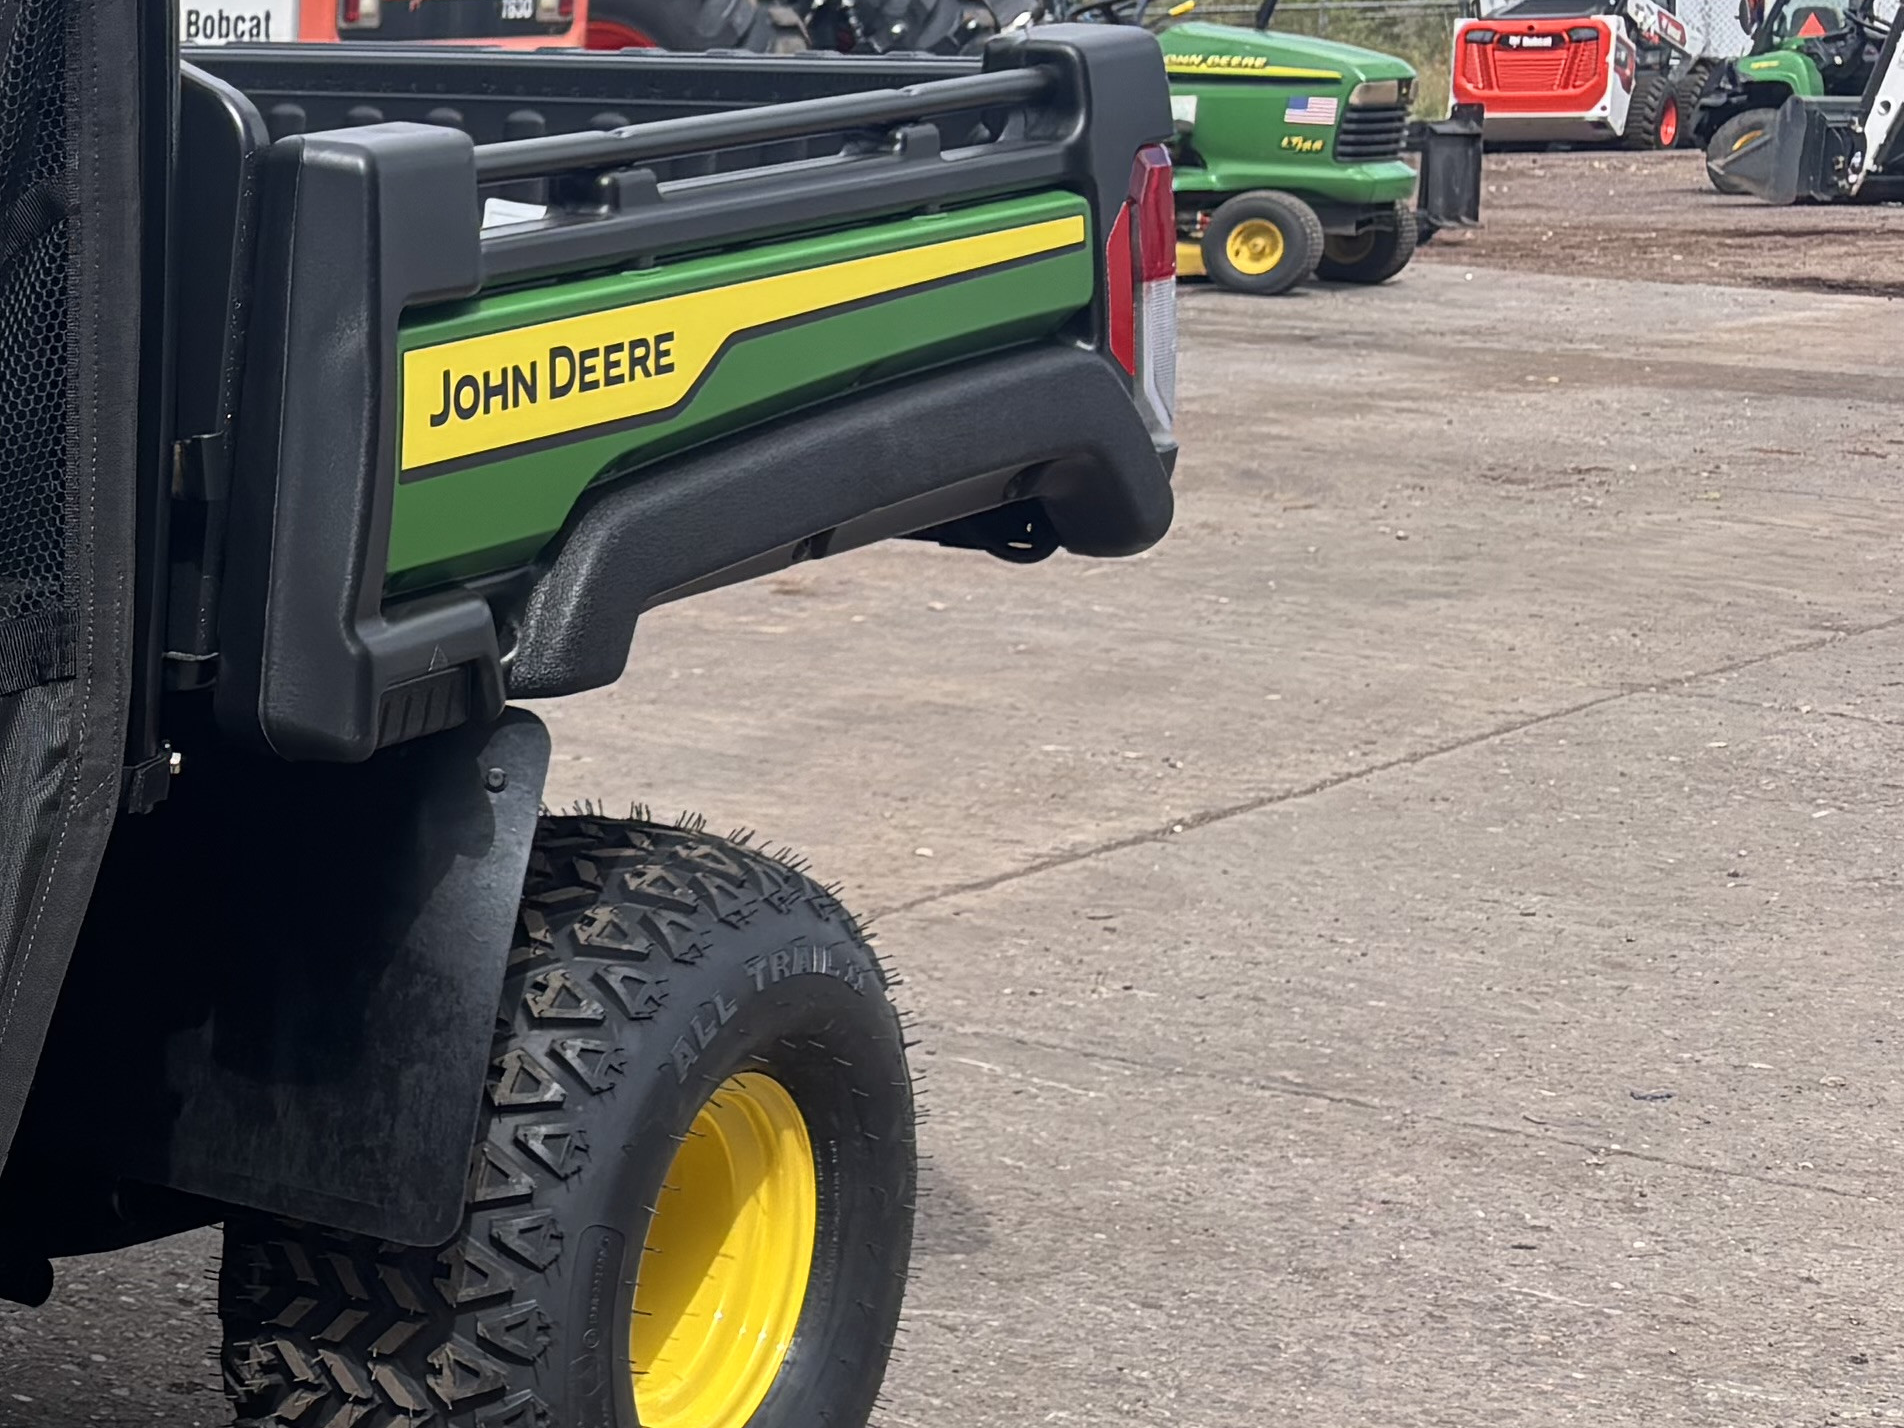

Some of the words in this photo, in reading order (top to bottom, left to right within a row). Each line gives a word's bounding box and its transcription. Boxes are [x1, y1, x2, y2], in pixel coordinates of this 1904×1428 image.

[186, 9, 271, 42] Bobcat
[429, 360, 541, 429] JOHN
[548, 330, 677, 401] DEERE
